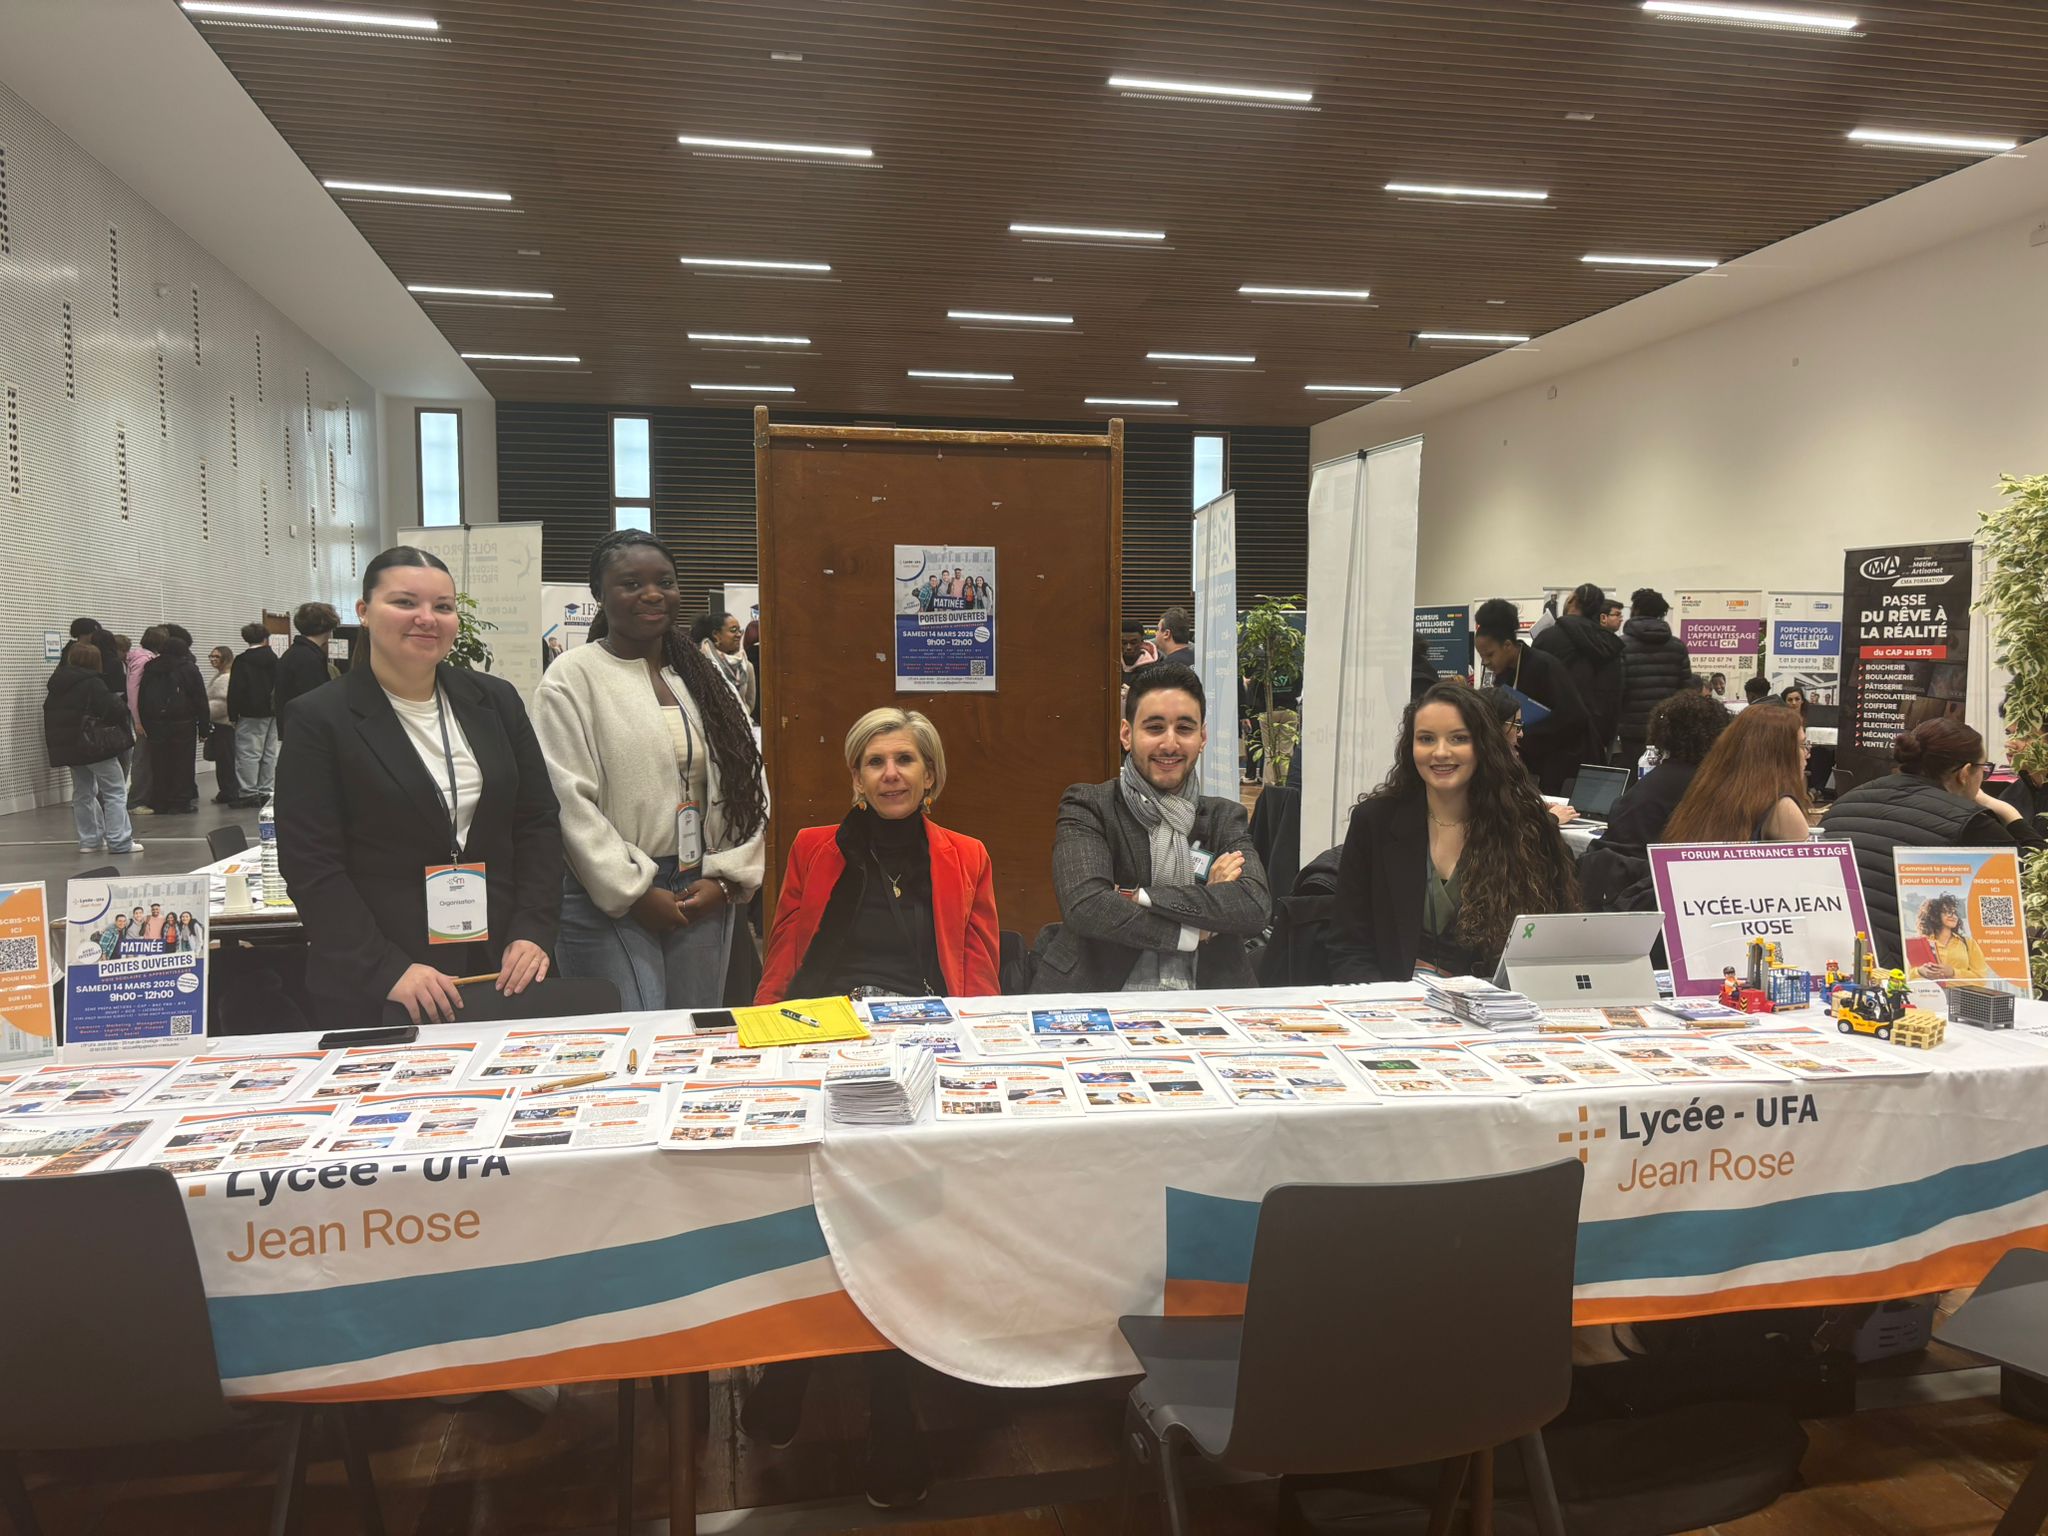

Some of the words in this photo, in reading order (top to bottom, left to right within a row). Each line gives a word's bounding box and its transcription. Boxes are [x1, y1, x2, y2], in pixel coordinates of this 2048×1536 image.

[934, 597, 964, 608] MATINÉE
[1882, 594, 1926, 606] PASSE
[920, 614, 947, 623] PORTES
[949, 612, 985, 621] OUVERTES
[1861, 610, 1884, 622] DU
[1888, 606, 1931, 622] RÊVE
[1935, 605, 1948, 621] À
[1860, 627, 1880, 638] LA
[1884, 622, 1947, 638] RÉALITÉ
[1681, 851, 1720, 860] FORUM
[1723, 849, 1794, 858] ALTERNANCE
[1814, 847, 1848, 856] STAGE
[1795, 896, 1842, 914] JEAN
[1741, 919, 1794, 935] ROSE
[120, 940, 163, 953] MATINÉE
[101, 961, 139, 974] PORTES
[141, 954, 192, 970] OUVERTES
[76, 984, 111, 993] SAMEDI
[124, 981, 151, 990] MARS
[153, 980, 175, 988] 2026
[110, 992, 136, 1002] 9h00
[144, 990, 174, 999] 12h00
[1619, 1097, 1725, 1147] Lycée
[1756, 1094, 1818, 1128] UFA
[1617, 1158, 1698, 1192] Jean
[1709, 1148, 1795, 1181] Rose
[226, 1162, 378, 1206] Lycée
[423, 1155, 510, 1182] UFA
[226, 1221, 346, 1262] Jean
[363, 1208, 480, 1248] Rose
